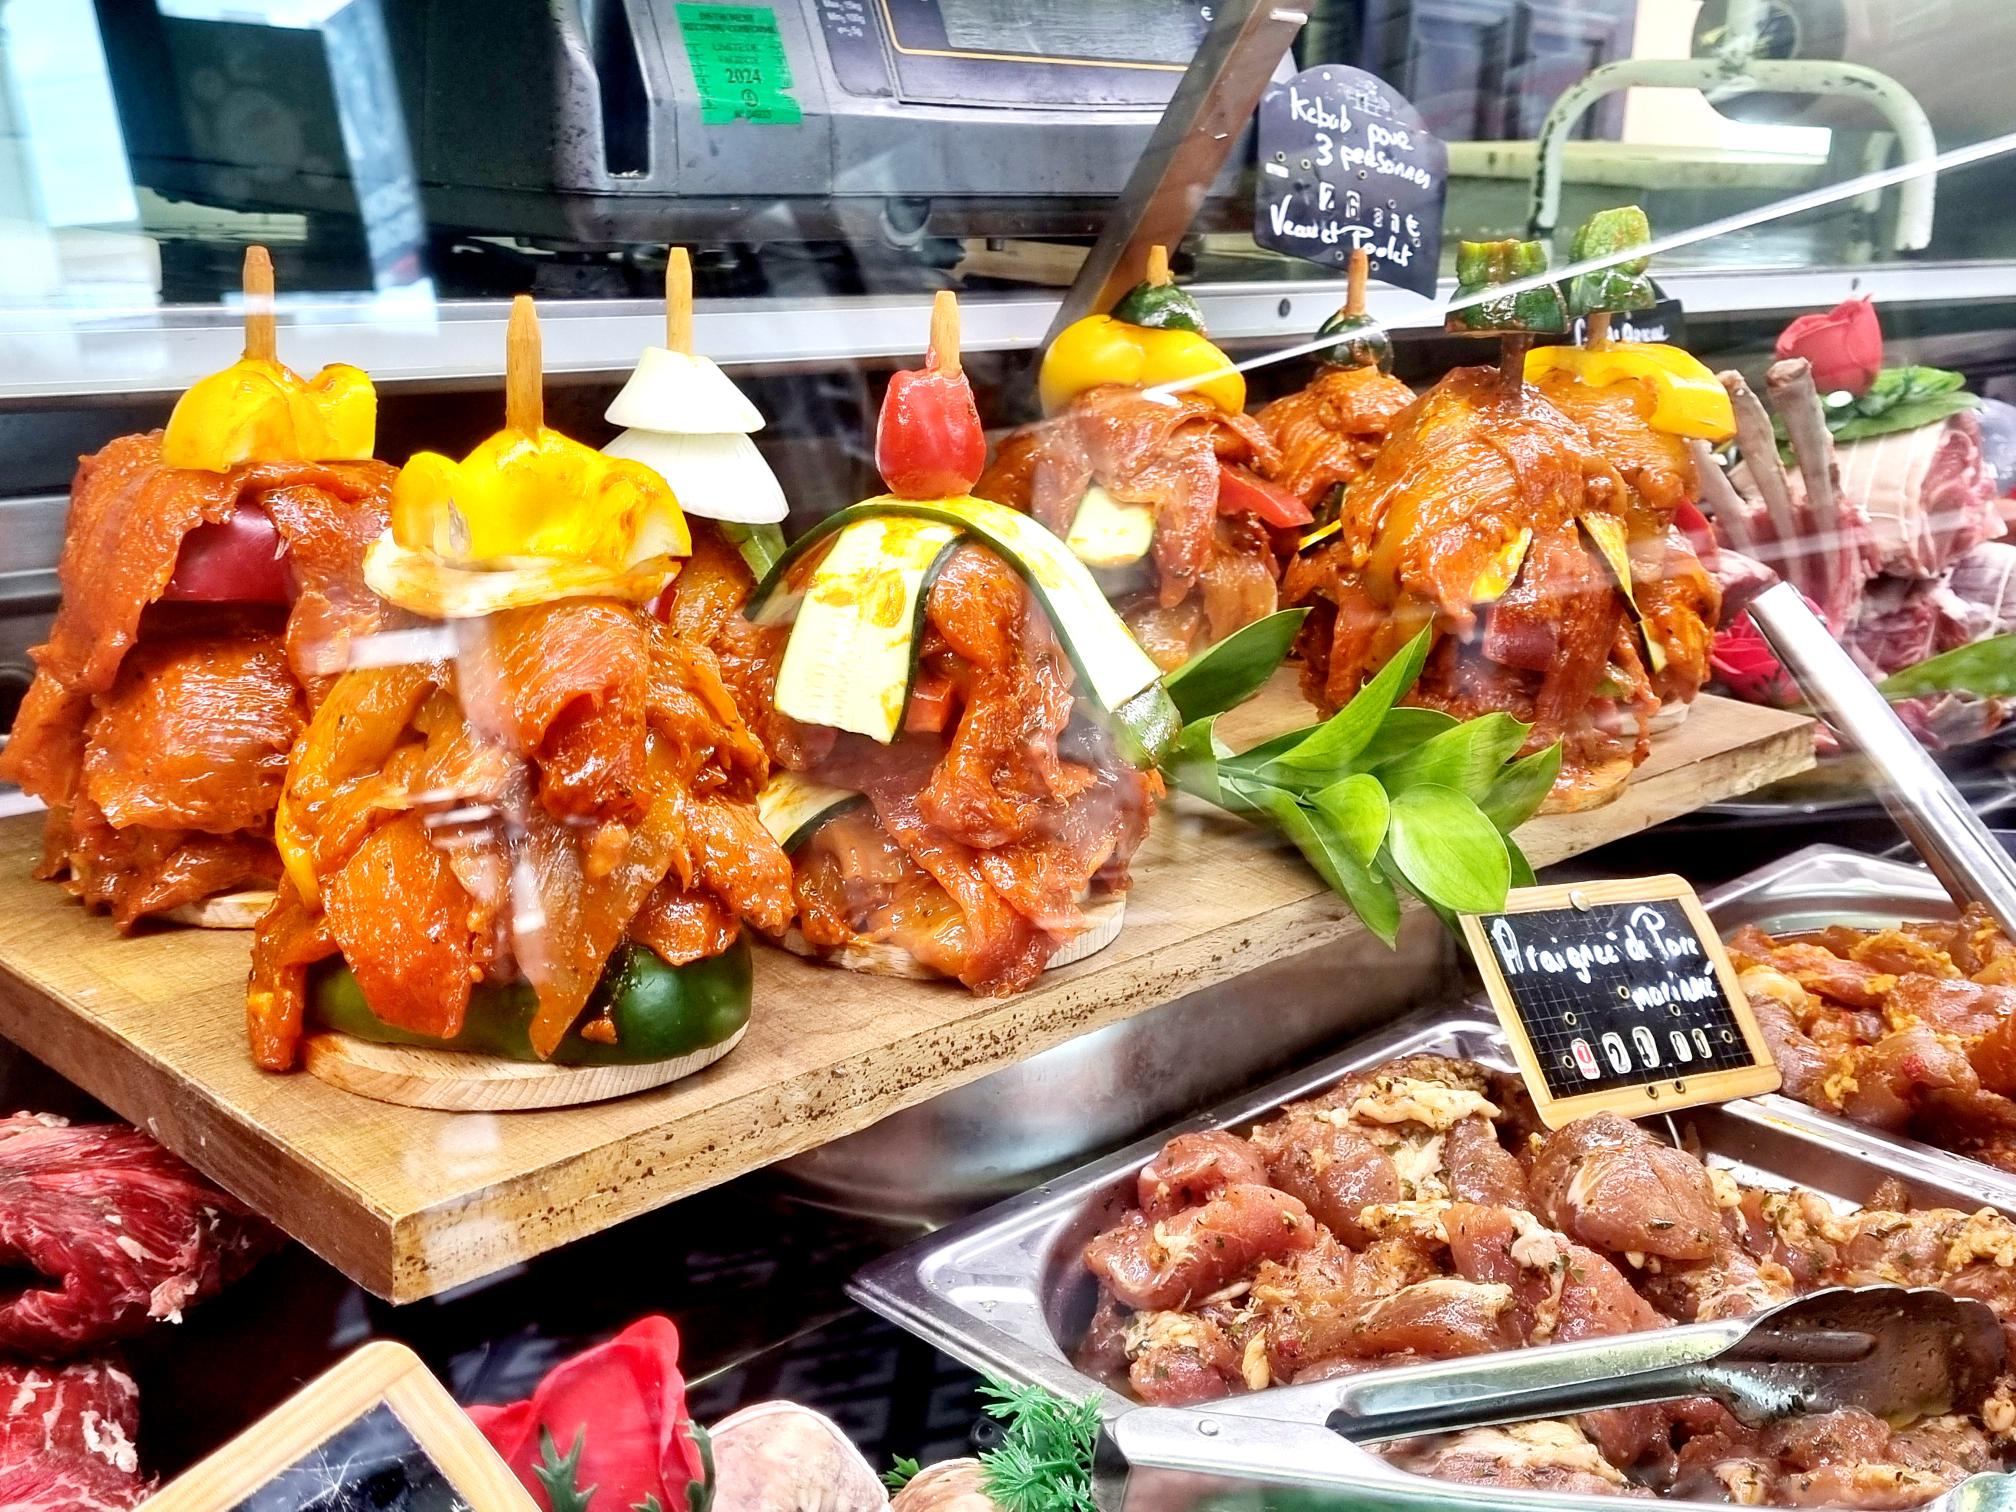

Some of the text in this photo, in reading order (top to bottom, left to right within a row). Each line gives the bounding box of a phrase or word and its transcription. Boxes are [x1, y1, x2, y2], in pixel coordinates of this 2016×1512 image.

[724, 68, 763, 85] 2024
[1314, 132, 1335, 167] 3
[1631, 905, 1699, 962] Porc
